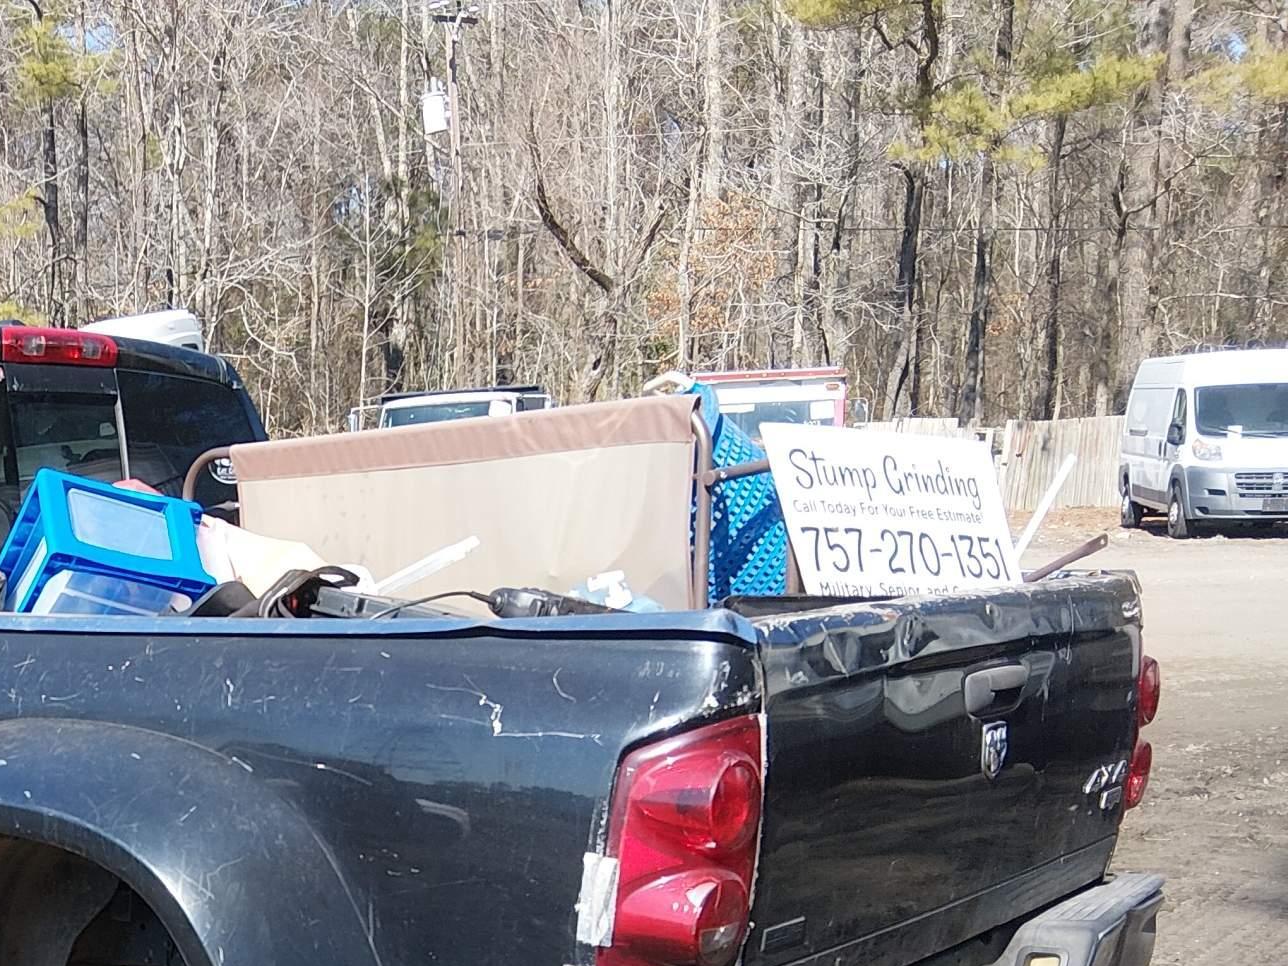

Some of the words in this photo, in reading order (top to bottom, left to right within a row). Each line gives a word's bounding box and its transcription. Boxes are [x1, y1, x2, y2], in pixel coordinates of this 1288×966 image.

[789, 448, 877, 501] Stump
[883, 455, 982, 510] Grinding
[793, 500, 817, 513] Call
[822, 500, 856, 516] Today
[860, 503, 879, 515] For
[883, 504, 907, 518] Your
[910, 507, 935, 520] Free
[801, 526, 1011, 581] 757-270-1351
